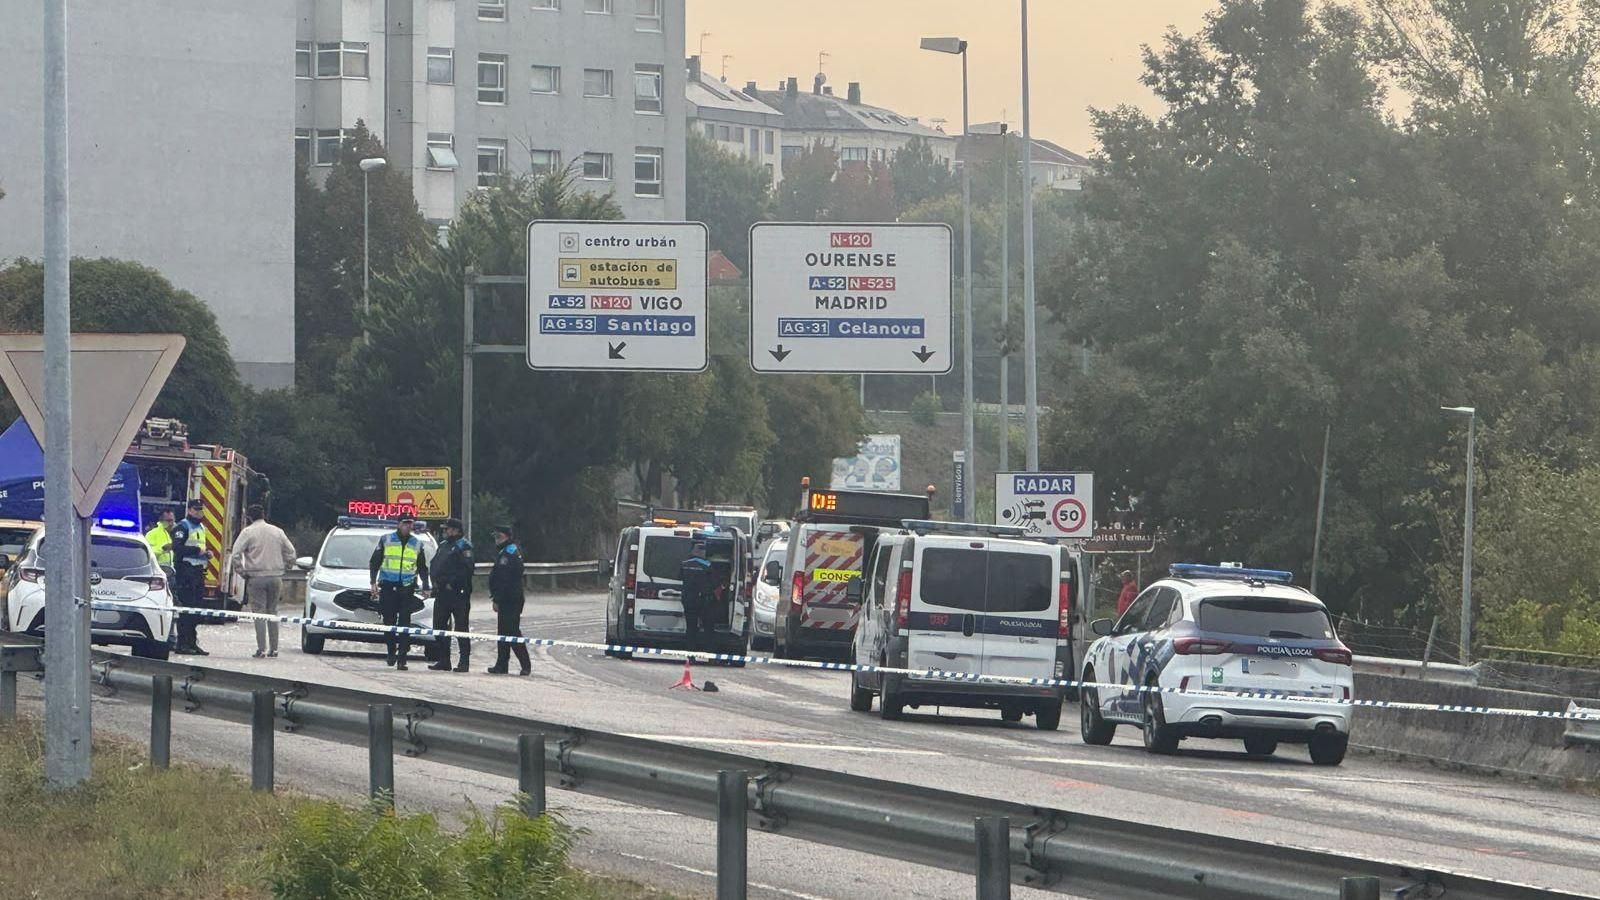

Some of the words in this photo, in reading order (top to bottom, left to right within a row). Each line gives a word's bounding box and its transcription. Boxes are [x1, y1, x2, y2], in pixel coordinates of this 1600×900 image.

[585, 236, 630, 248] centro
[636, 236, 677, 248] urbán
[831, 234, 870, 246] N-120
[805, 253, 897, 267] OURENSE
[589, 262, 648, 273] estación
[656, 263, 673, 272] de
[589, 276, 661, 286] autobuses
[811, 278, 845, 289] A-52
[849, 278, 894, 289] N-525
[551, 297, 585, 308] A-52
[592, 297, 631, 308] N-120
[640, 296, 683, 310] VIGO
[815, 296, 888, 310] MADRID
[544, 319, 594, 330] AG-53
[607, 318, 692, 334] Santiago
[783, 322, 827, 333] AG-31
[838, 321, 921, 334] Celanova
[1016, 478, 1072, 492] RADAR
[1059, 510, 1079, 522] 50
